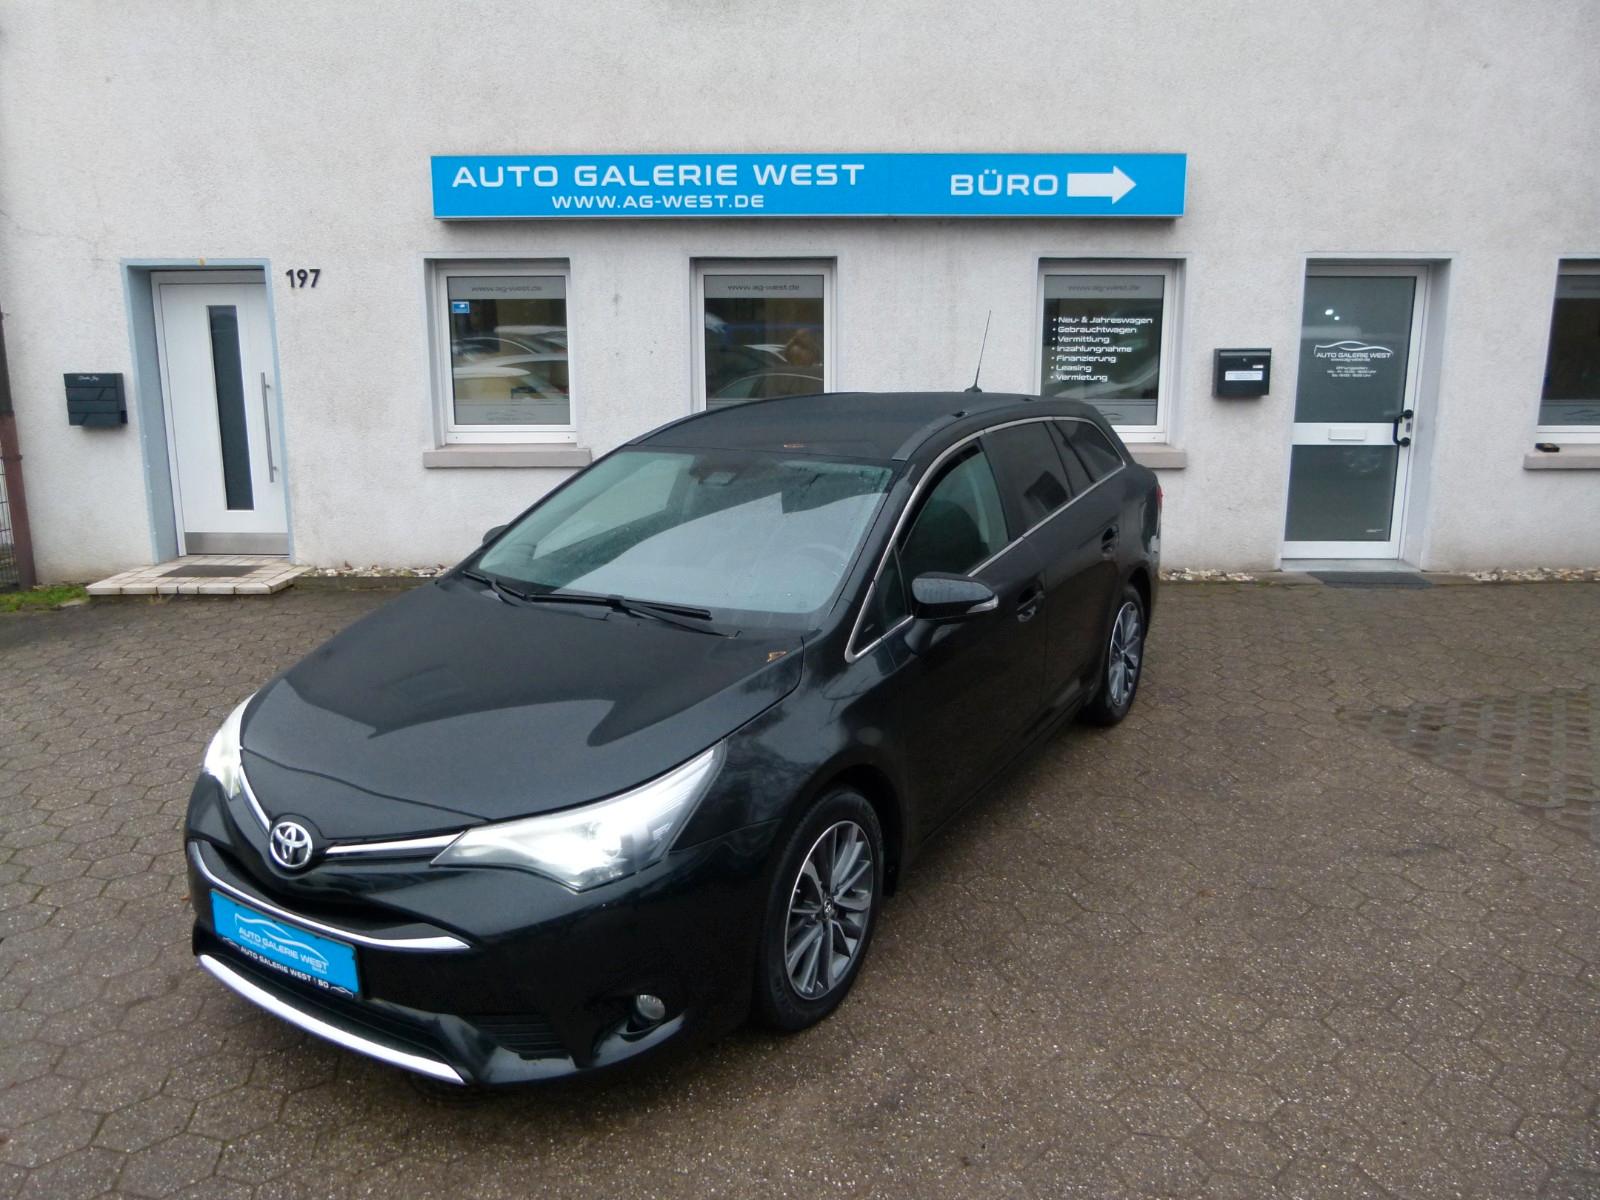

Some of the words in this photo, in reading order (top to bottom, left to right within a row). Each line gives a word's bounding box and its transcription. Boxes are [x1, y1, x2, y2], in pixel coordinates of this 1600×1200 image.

[452, 165, 559, 188] AUTO
[574, 164, 738, 187] GALERIE
[753, 163, 865, 187] WEST
[950, 169, 1059, 196] BÜRO
[551, 194, 765, 210] WWW.AG-WEST.DE
[286, 268, 321, 288] 197
[1058, 316, 1079, 324] Neu-
[1081, 316, 1088, 324] &
[1089, 316, 1153, 325] Jahreswagen
[1058, 326, 1137, 334] Gebrauchtwagen
[1057, 336, 1110, 344] Vermittlung
[1056, 345, 1132, 353] Inzahlungnahme
[1056, 355, 1117, 363] Finanzierung
[1056, 364, 1092, 373] Leasing
[1055, 374, 1108, 382] Vermietung
[239, 927, 262, 943] AUTO
[262, 938, 299, 960] GALERIE
[300, 953, 328, 970] WEST
[240, 946, 258, 960] AUTO
[259, 955, 289, 974] GALERIE
[289, 968, 312, 982] WEST
